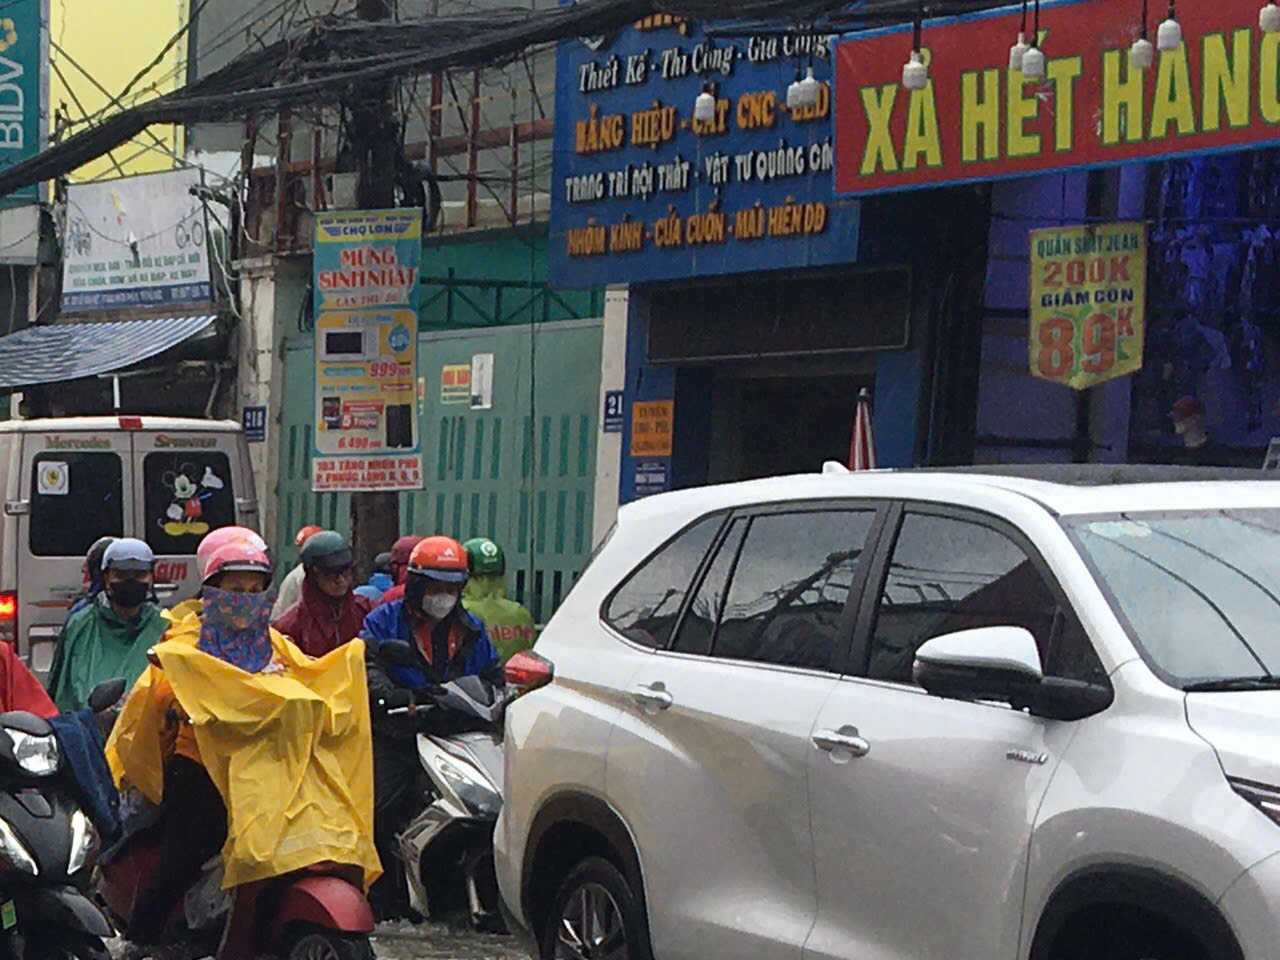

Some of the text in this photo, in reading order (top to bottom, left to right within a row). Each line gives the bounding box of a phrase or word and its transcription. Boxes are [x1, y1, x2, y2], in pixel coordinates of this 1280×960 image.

[576, 104, 624, 152] BẢNG
[631, 99, 676, 151] HIỆU
[737, 91, 777, 129] CNC
[859, 48, 943, 176] XẢ
[960, 29, 1083, 164] HẾT
[705, 151, 728, 195] VẬT
[736, 151, 753, 182] TƯ
[756, 137, 804, 180] QUẢNG
[810, 137, 833, 171] CÁ
[687, 200, 726, 244] CUỐN
[1042, 256, 1131, 287] 200K
[45, 434, 112, 449] Mercedes
